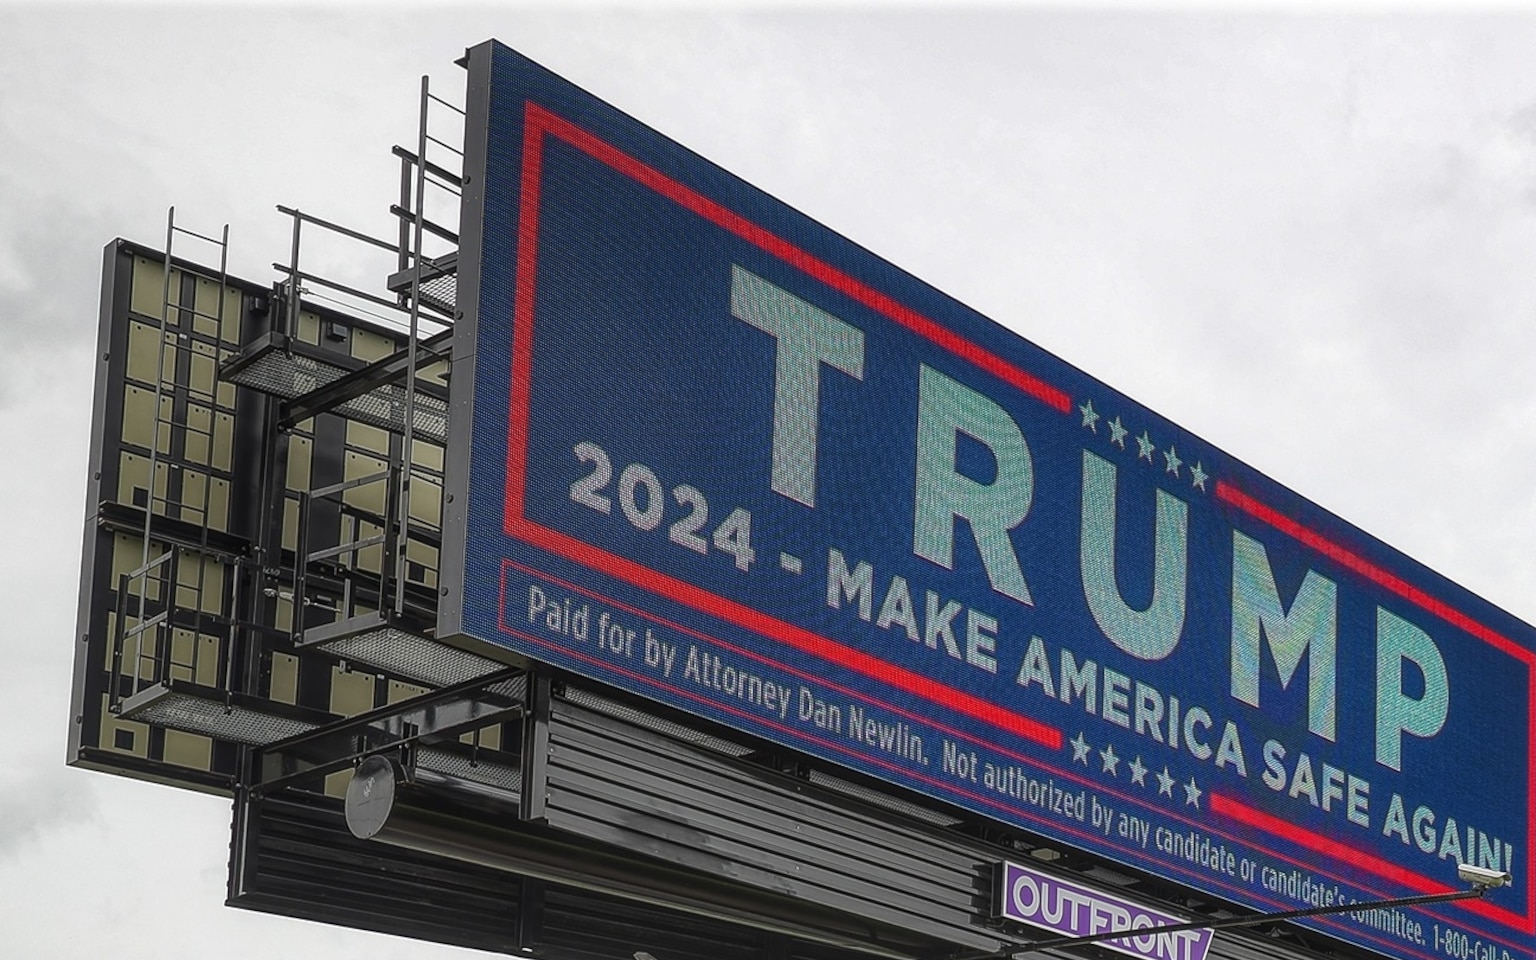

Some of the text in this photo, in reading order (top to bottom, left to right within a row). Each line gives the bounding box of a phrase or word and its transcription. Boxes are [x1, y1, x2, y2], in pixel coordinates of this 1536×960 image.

[569, 441, 1512, 888] 2024 - MAKE AMERICA SAFE AGAIN!
[731, 263, 1450, 772] TRUMP
[527, 585, 590, 642] Paid
[599, 612, 636, 658] for
[644, 621, 677, 677] by
[684, 645, 791, 720] Attorney
[799, 686, 841, 733] Dan
[849, 704, 929, 766] Newlin.
[943, 739, 978, 783] Not
[984, 762, 1085, 822] authorized
[1091, 794, 1114, 836] by
[1118, 813, 1150, 849] any
[1155, 826, 1236, 877] candidate
[1240, 861, 1256, 883] or
[1261, 863, 1346, 916] candidate's
